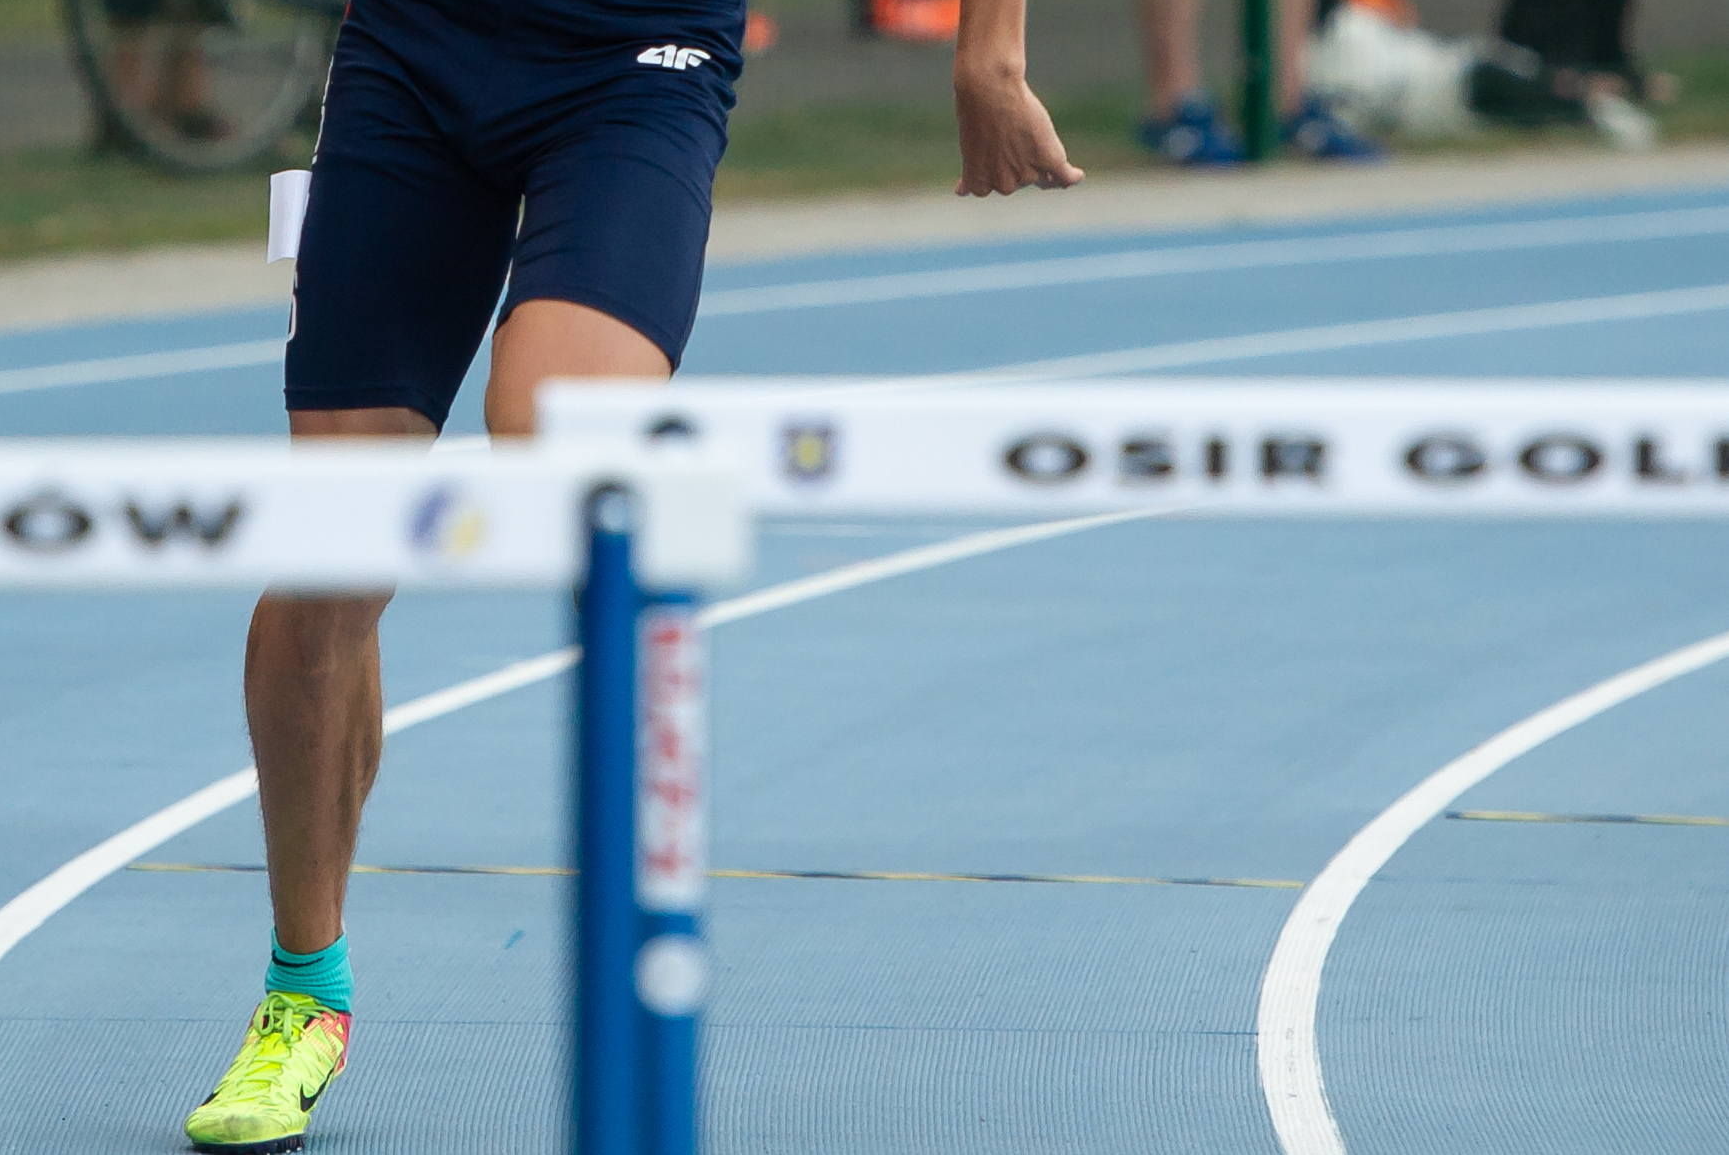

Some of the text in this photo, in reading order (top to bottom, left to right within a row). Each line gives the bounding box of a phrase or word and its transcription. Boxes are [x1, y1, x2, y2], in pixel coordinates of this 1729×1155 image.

[636, 44, 711, 70] 4F
[999, 427, 1729, 488] OSIR GOL
